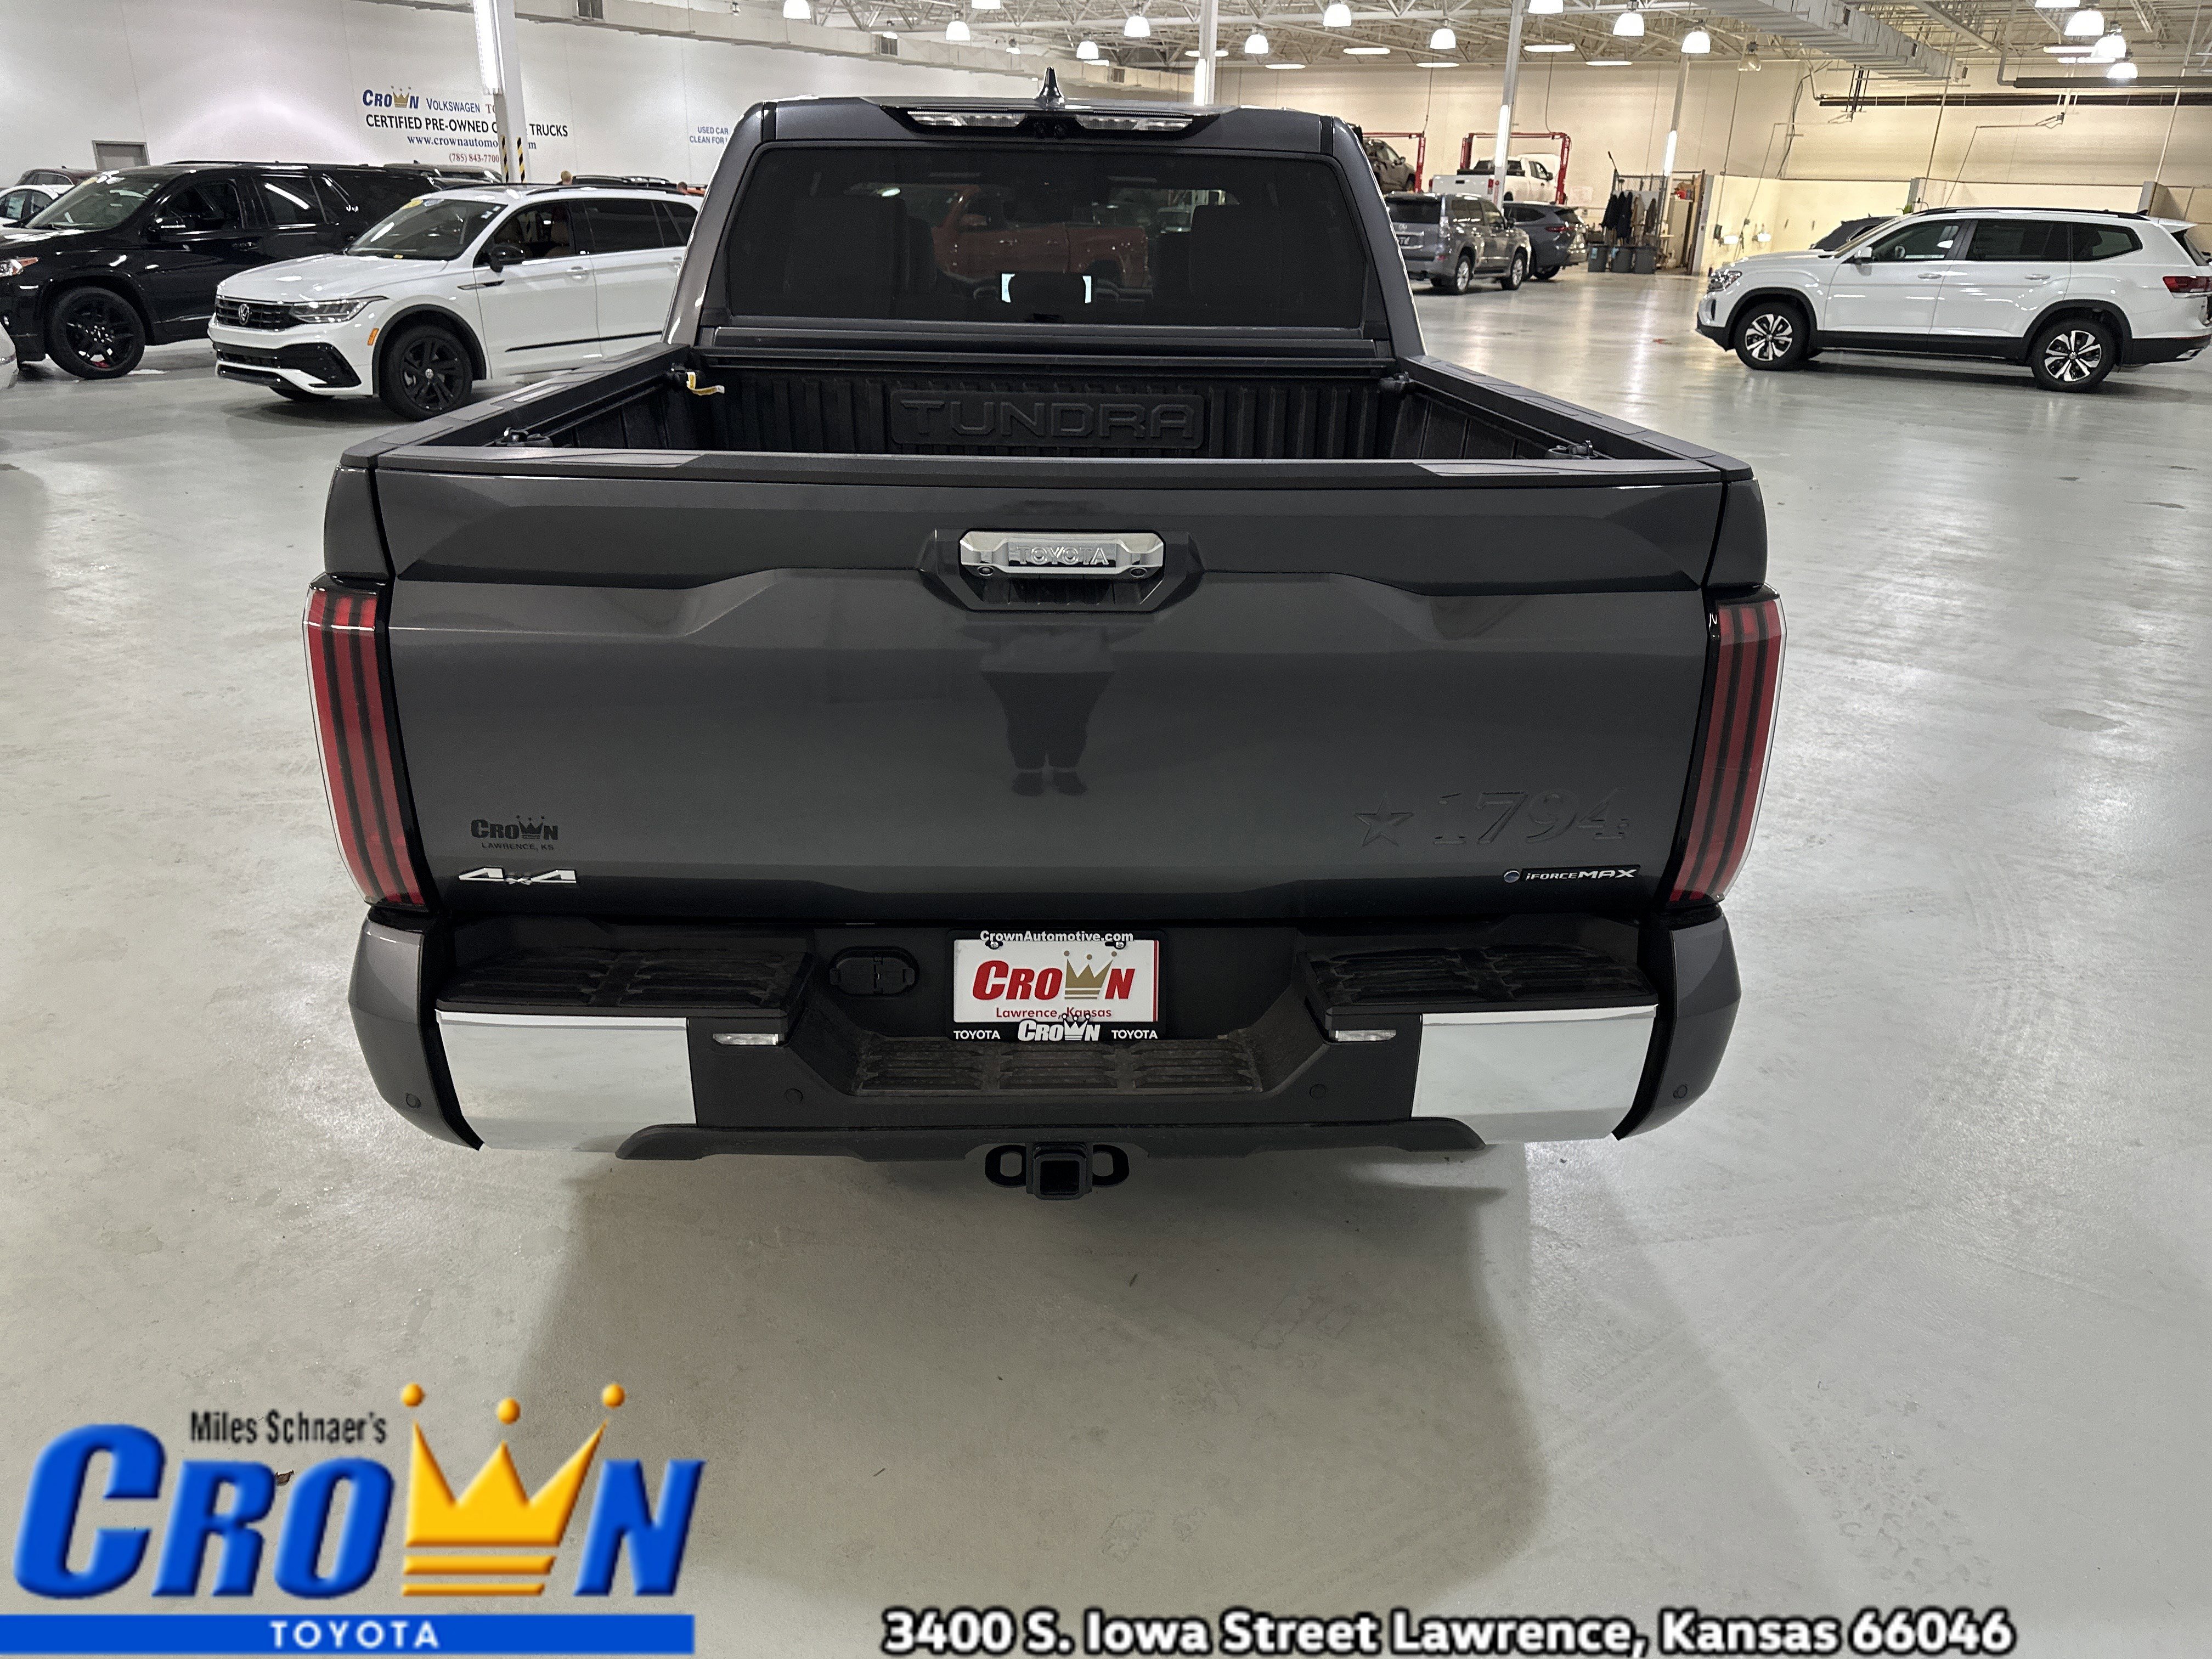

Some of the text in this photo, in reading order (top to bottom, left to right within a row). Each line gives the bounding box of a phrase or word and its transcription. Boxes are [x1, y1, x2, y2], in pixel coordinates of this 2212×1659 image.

[426, 98, 481, 113] VOLKSWAGEN
[366, 114, 422, 129] CERTIFIED
[425, 117, 489, 133] PRE-OWNED
[529, 123, 568, 137] TRUCKS
[449, 153, 500, 163] (785) 843-7700
[900, 399, 1196, 439] TUNDRA
[1015, 545, 1110, 566] TOYOTA
[1433, 787, 1630, 845] 1794
[470, 815, 558, 840] CROWN
[481, 842, 539, 851] LAWRENCE,
[980, 930, 1134, 942] CrownAutomotive.com
[972, 950, 1136, 1001] CROWN
[996, 1007, 1112, 1019] Lawrence, Kansas
[953, 1030, 1001, 1040] TOYOTA
[1017, 1014, 1101, 1042] CROWN
[1111, 1029, 1159, 1040] TOYOTA
